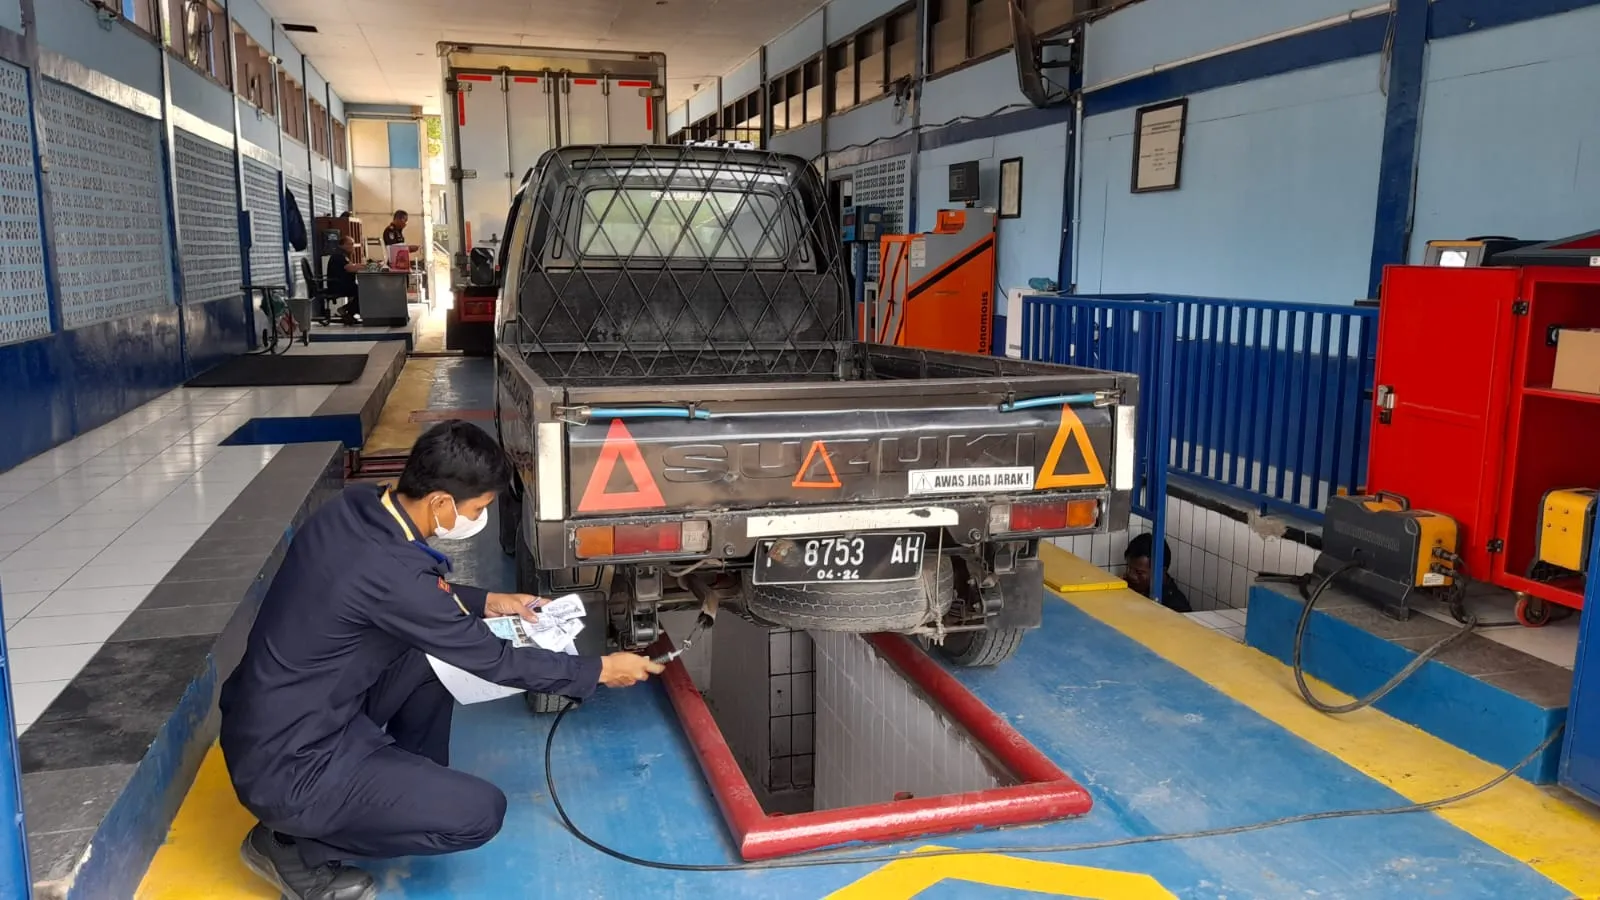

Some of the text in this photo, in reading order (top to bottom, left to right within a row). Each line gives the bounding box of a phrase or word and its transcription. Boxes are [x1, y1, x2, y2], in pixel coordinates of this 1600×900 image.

[977, 291, 989, 353] tonomous
[662, 433, 1036, 482] SUZUKI
[934, 475, 965, 488] AWAS
[967, 473, 991, 487] JAGA
[993, 472, 1024, 486] JARAK
[804, 538, 865, 567] 8753
[890, 536, 921, 564] AH
